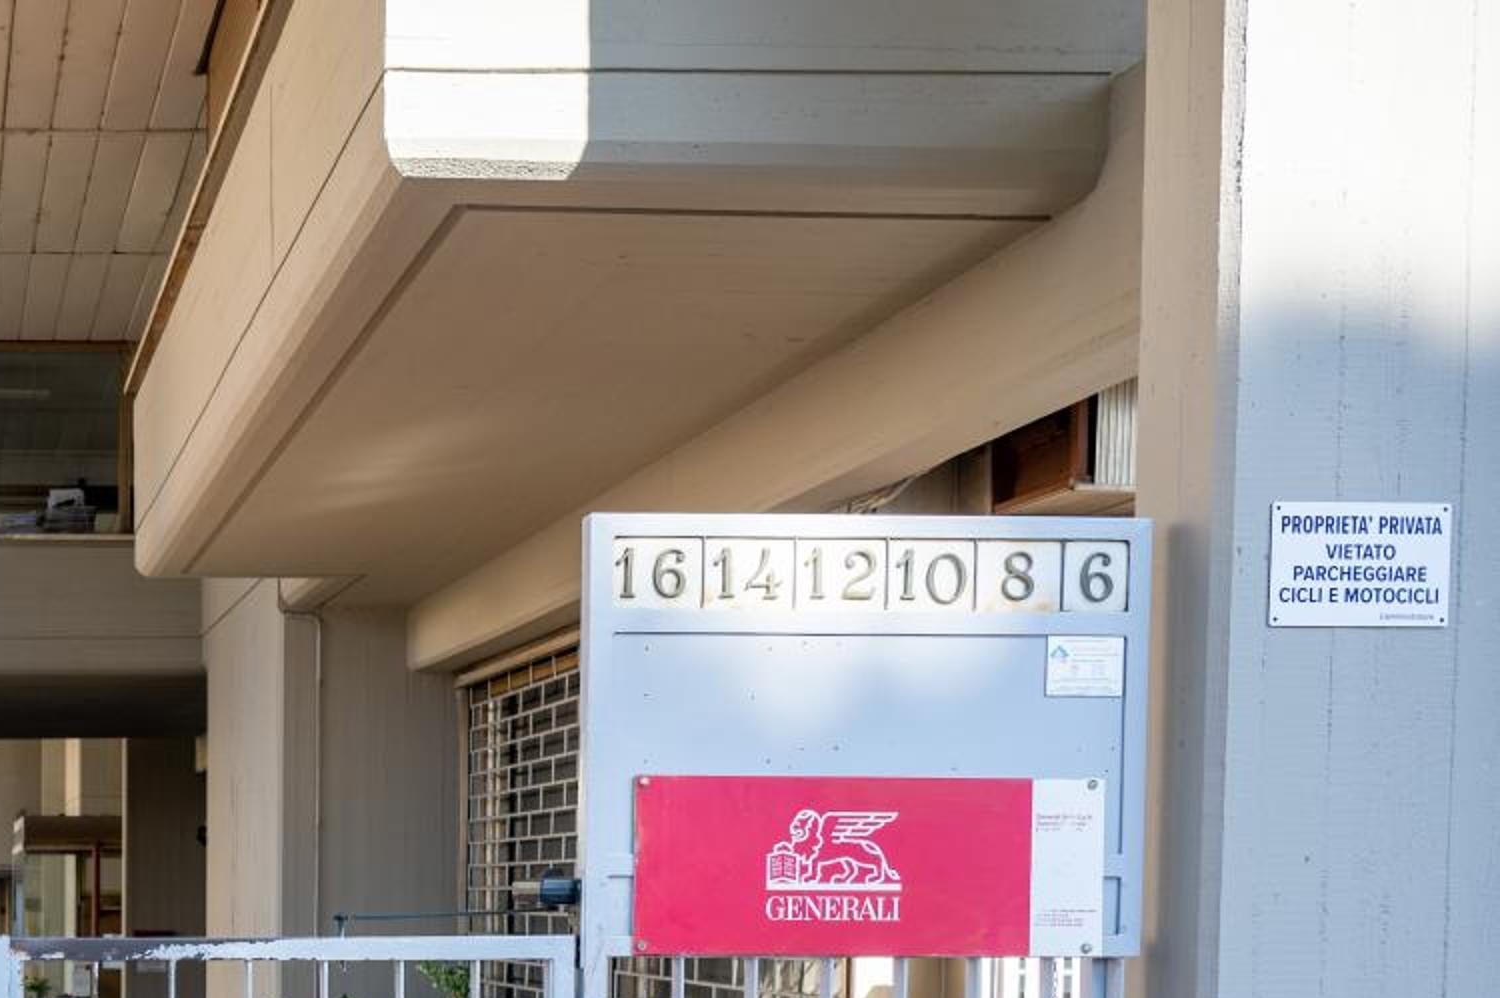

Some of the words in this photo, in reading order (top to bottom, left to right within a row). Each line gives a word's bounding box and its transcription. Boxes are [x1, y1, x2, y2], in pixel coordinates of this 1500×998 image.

[1281, 515, 1373, 535] PROPRIETA'
[1379, 516, 1443, 535] PRIVATA
[1325, 543, 1397, 561] VIETATO
[615, 547, 686, 599] 16
[713, 547, 783, 600] 14
[804, 547, 877, 600] 12
[896, 548, 967, 605] 10
[1001, 551, 1035, 602] 8
[1080, 552, 1114, 603] 6
[1293, 565, 1428, 582] PARCHEGGIARE
[1279, 587, 1323, 603] CICLI
[1329, 588, 1339, 603] E
[1344, 588, 1440, 604] MOTOCICLI
[765, 895, 901, 921] GENERALI
